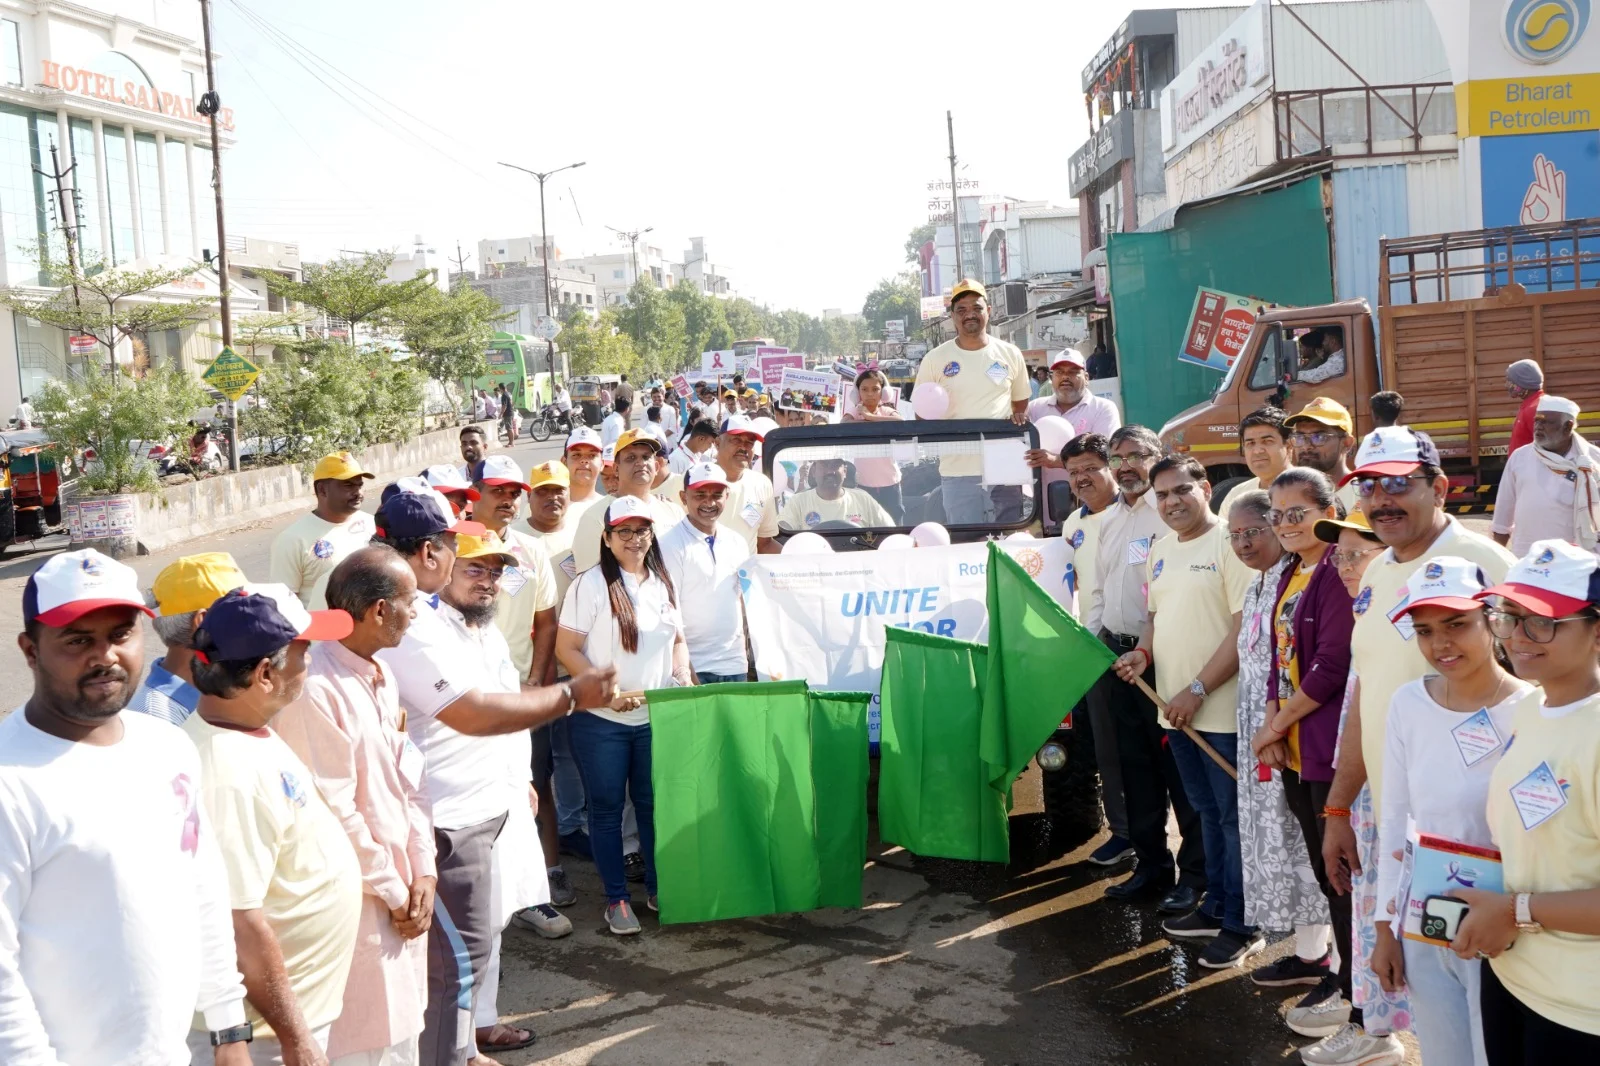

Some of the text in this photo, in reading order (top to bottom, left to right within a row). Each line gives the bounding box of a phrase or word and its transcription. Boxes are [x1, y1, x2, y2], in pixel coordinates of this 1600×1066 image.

[41, 59, 122, 103] HOTEL
[1506, 81, 1573, 102] Bharat
[1489, 108, 1590, 129] Petroleum
[928, 197, 951, 211] लॉज
[928, 213, 954, 222] LODGE
[959, 562, 986, 577] Rot
[841, 586, 940, 618] UNITE
